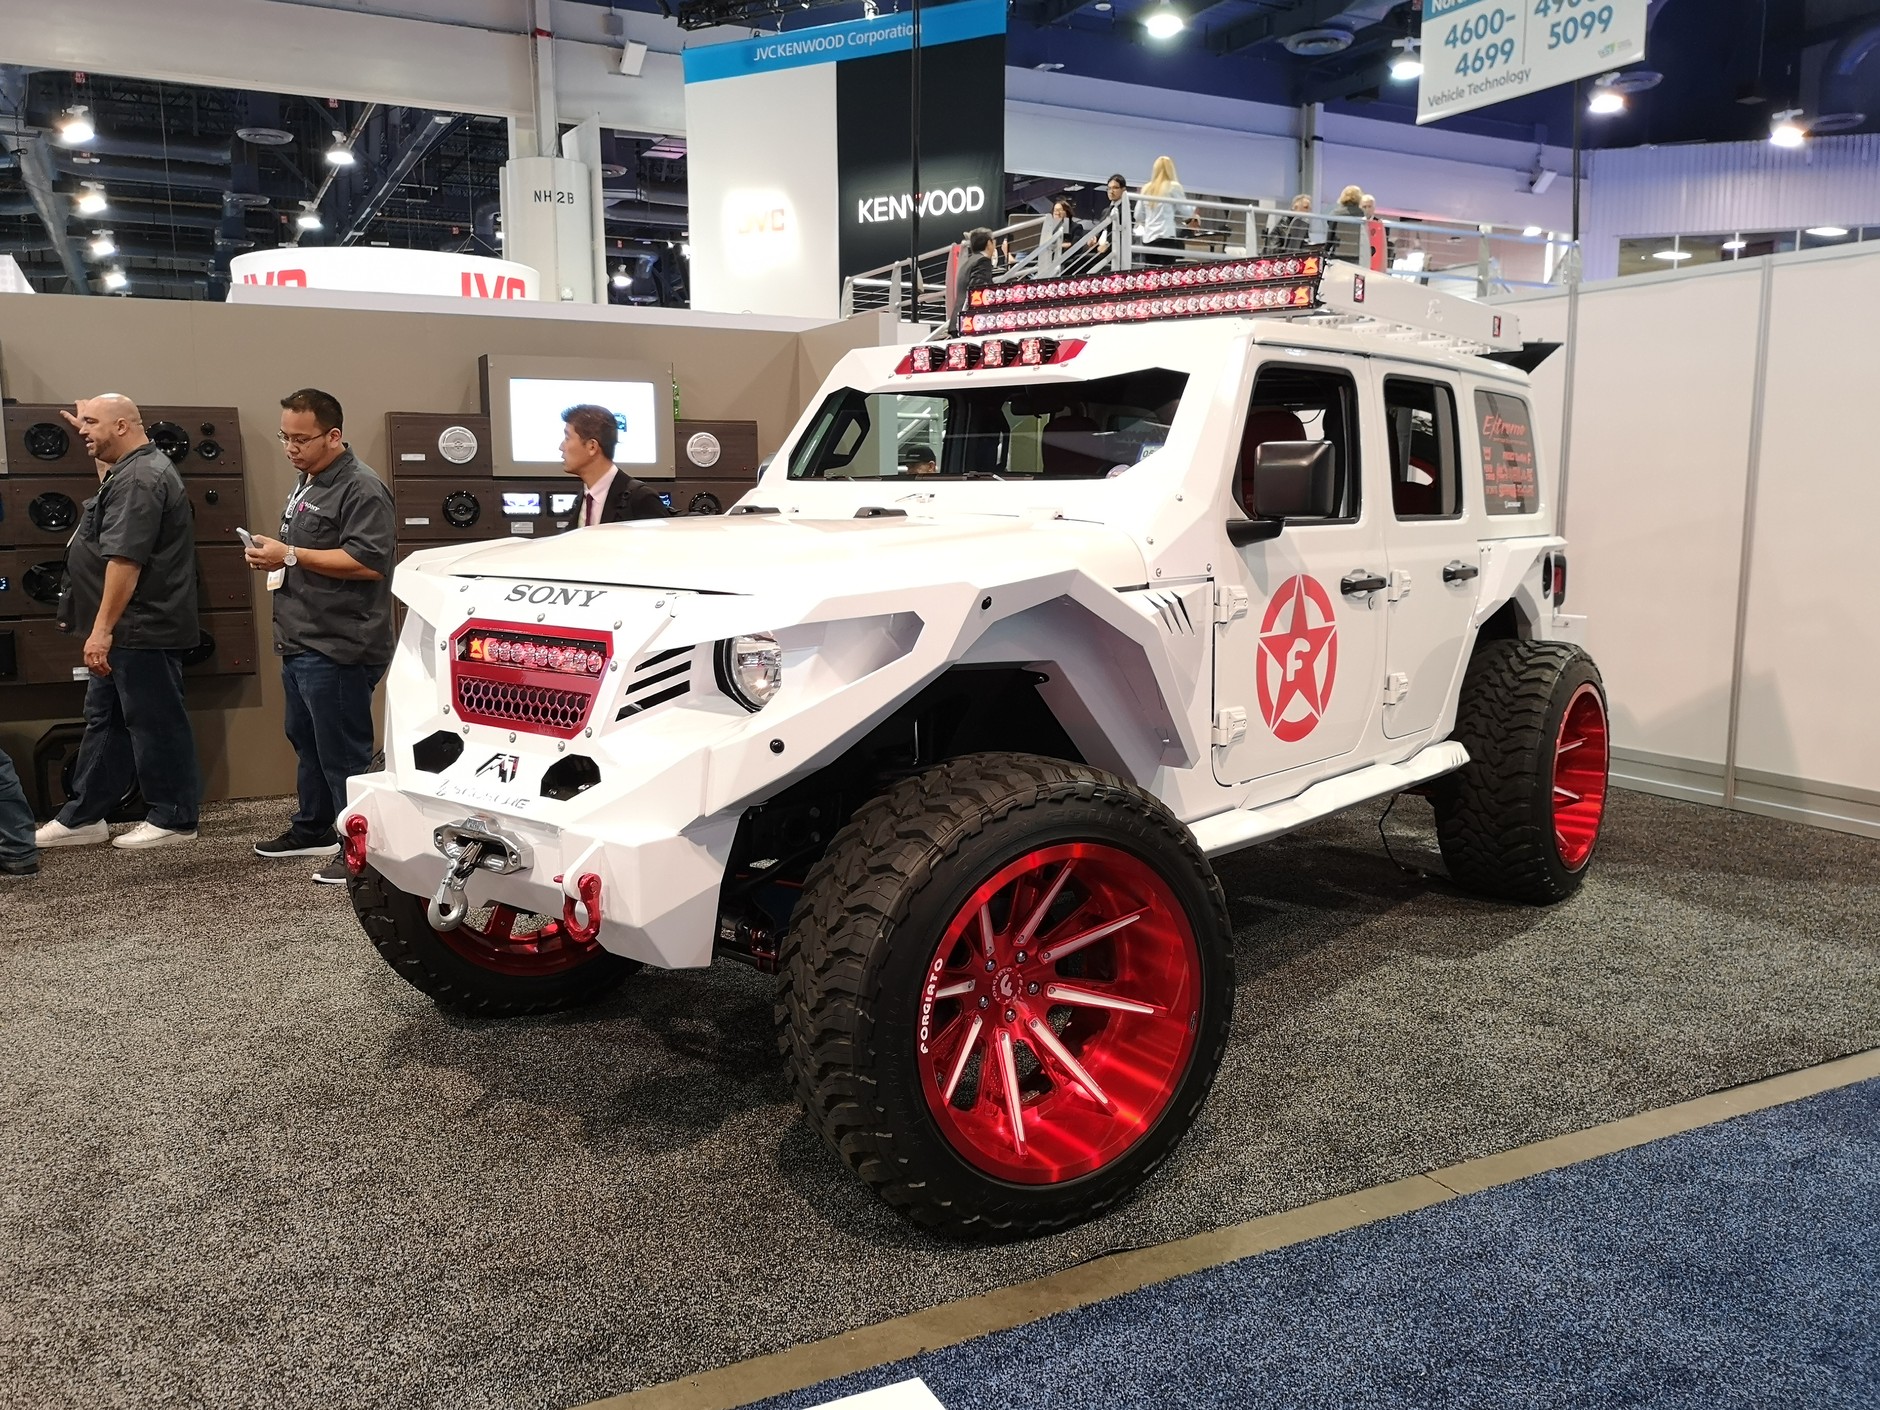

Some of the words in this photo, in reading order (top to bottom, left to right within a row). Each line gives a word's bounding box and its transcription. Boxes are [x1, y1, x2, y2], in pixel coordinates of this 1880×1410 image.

[754, 34, 845, 61] JVCKENWOOD
[1444, 8, 1517, 49] 4600-
[1548, 5, 1614, 50] 5099
[1455, 37, 1516, 77] 4699
[1428, 87, 1465, 108] Vehicle
[1468, 67, 1532, 96] Technology
[858, 186, 985, 224] KENWOOD
[504, 584, 608, 608] SONY
[920, 958, 943, 1054] FORGIATO
